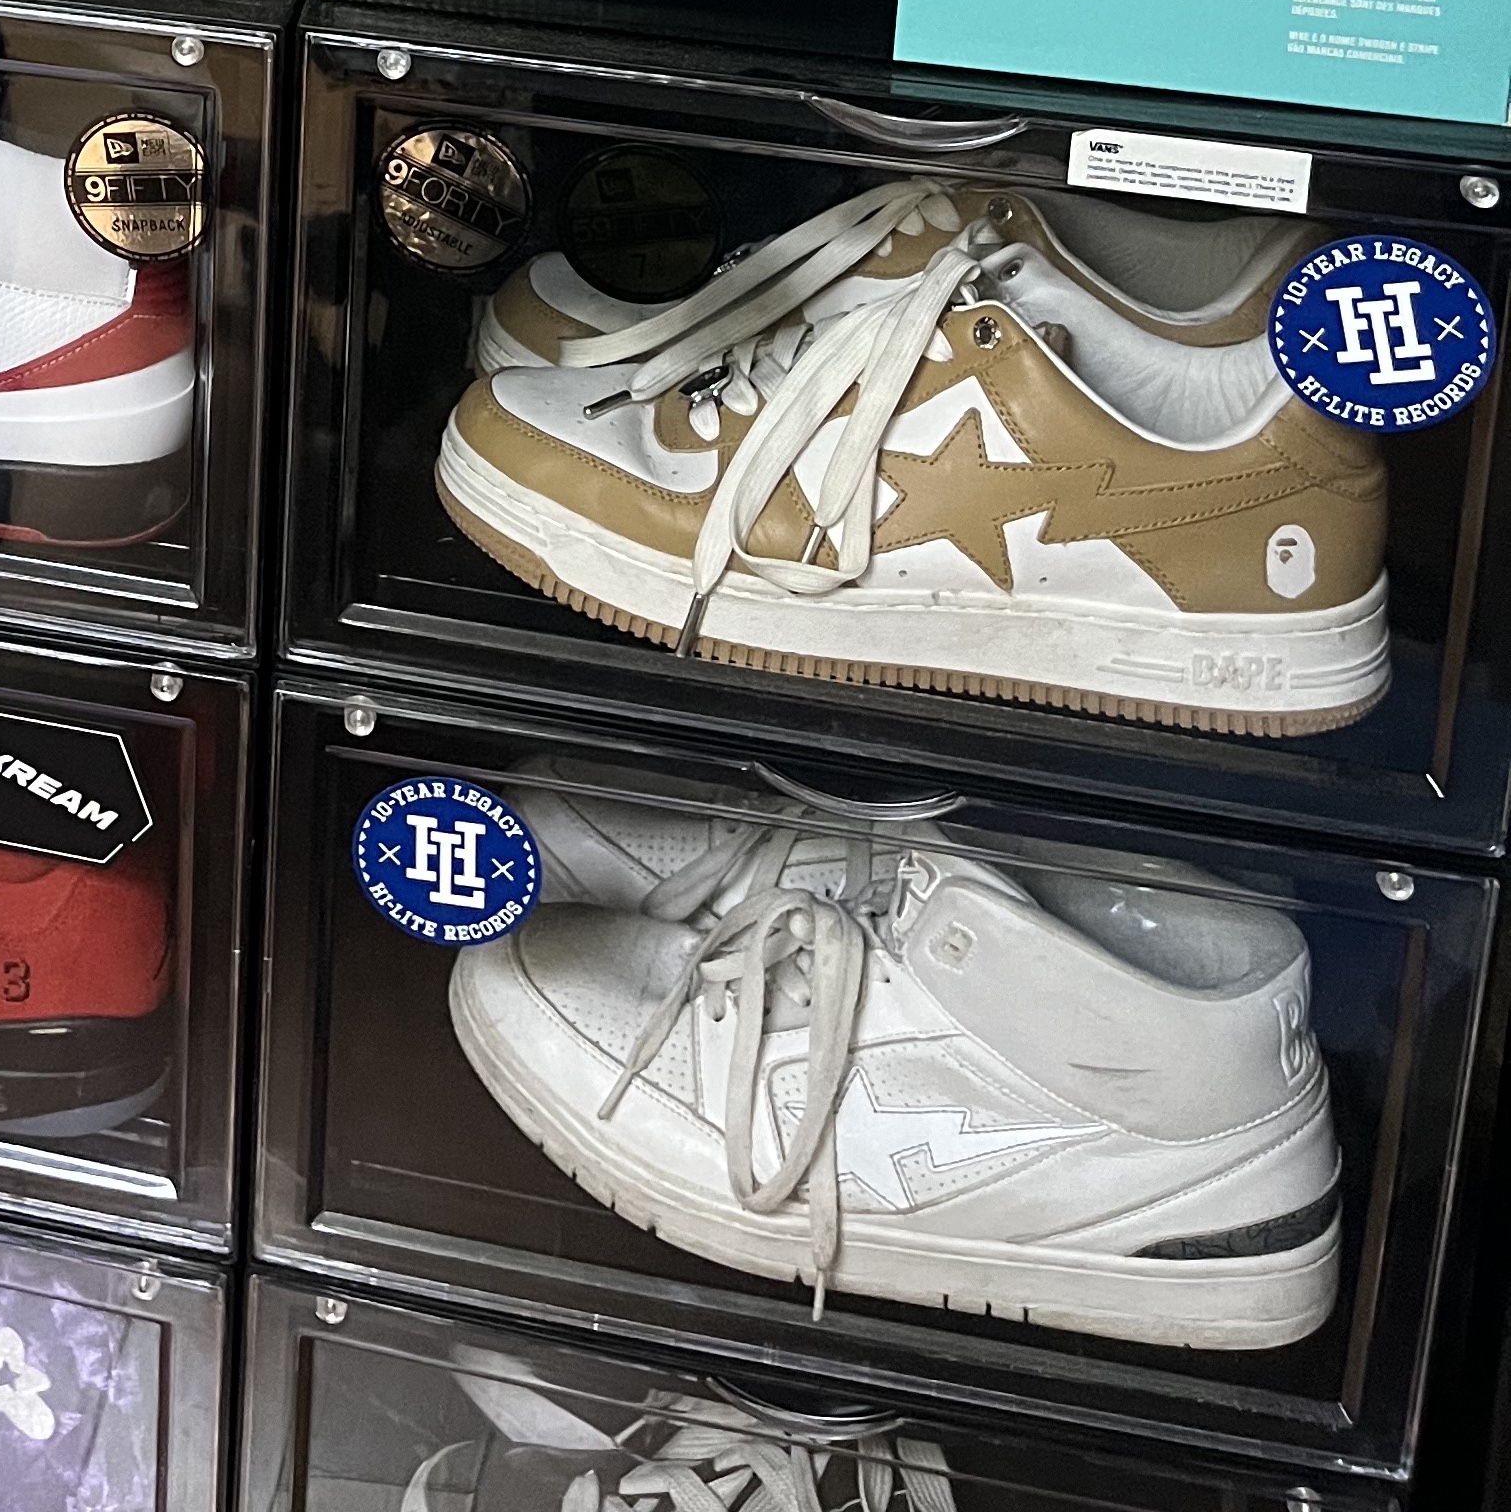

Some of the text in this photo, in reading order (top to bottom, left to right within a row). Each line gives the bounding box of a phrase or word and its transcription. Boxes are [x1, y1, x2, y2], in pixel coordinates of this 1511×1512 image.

[141, 138, 165, 148] NEW
[1089, 140, 1123, 154] VANS
[84, 175, 196, 202] 9FIFTY
[384, 158, 522, 237] 9FORTY
[112, 217, 186, 232] SNAPBACK
[399, 213, 474, 256] ADJUSTABLE
[1282, 241, 1466, 306] 10-YEAR LEGACY
[1297, 361, 1482, 426] HI-LITE RECORDS
[1191, 652, 1284, 692] BAPE
[370, 782, 524, 838] 10-YEAR LEGACY
[369, 881, 524, 941] HI-LITE RECORDS
